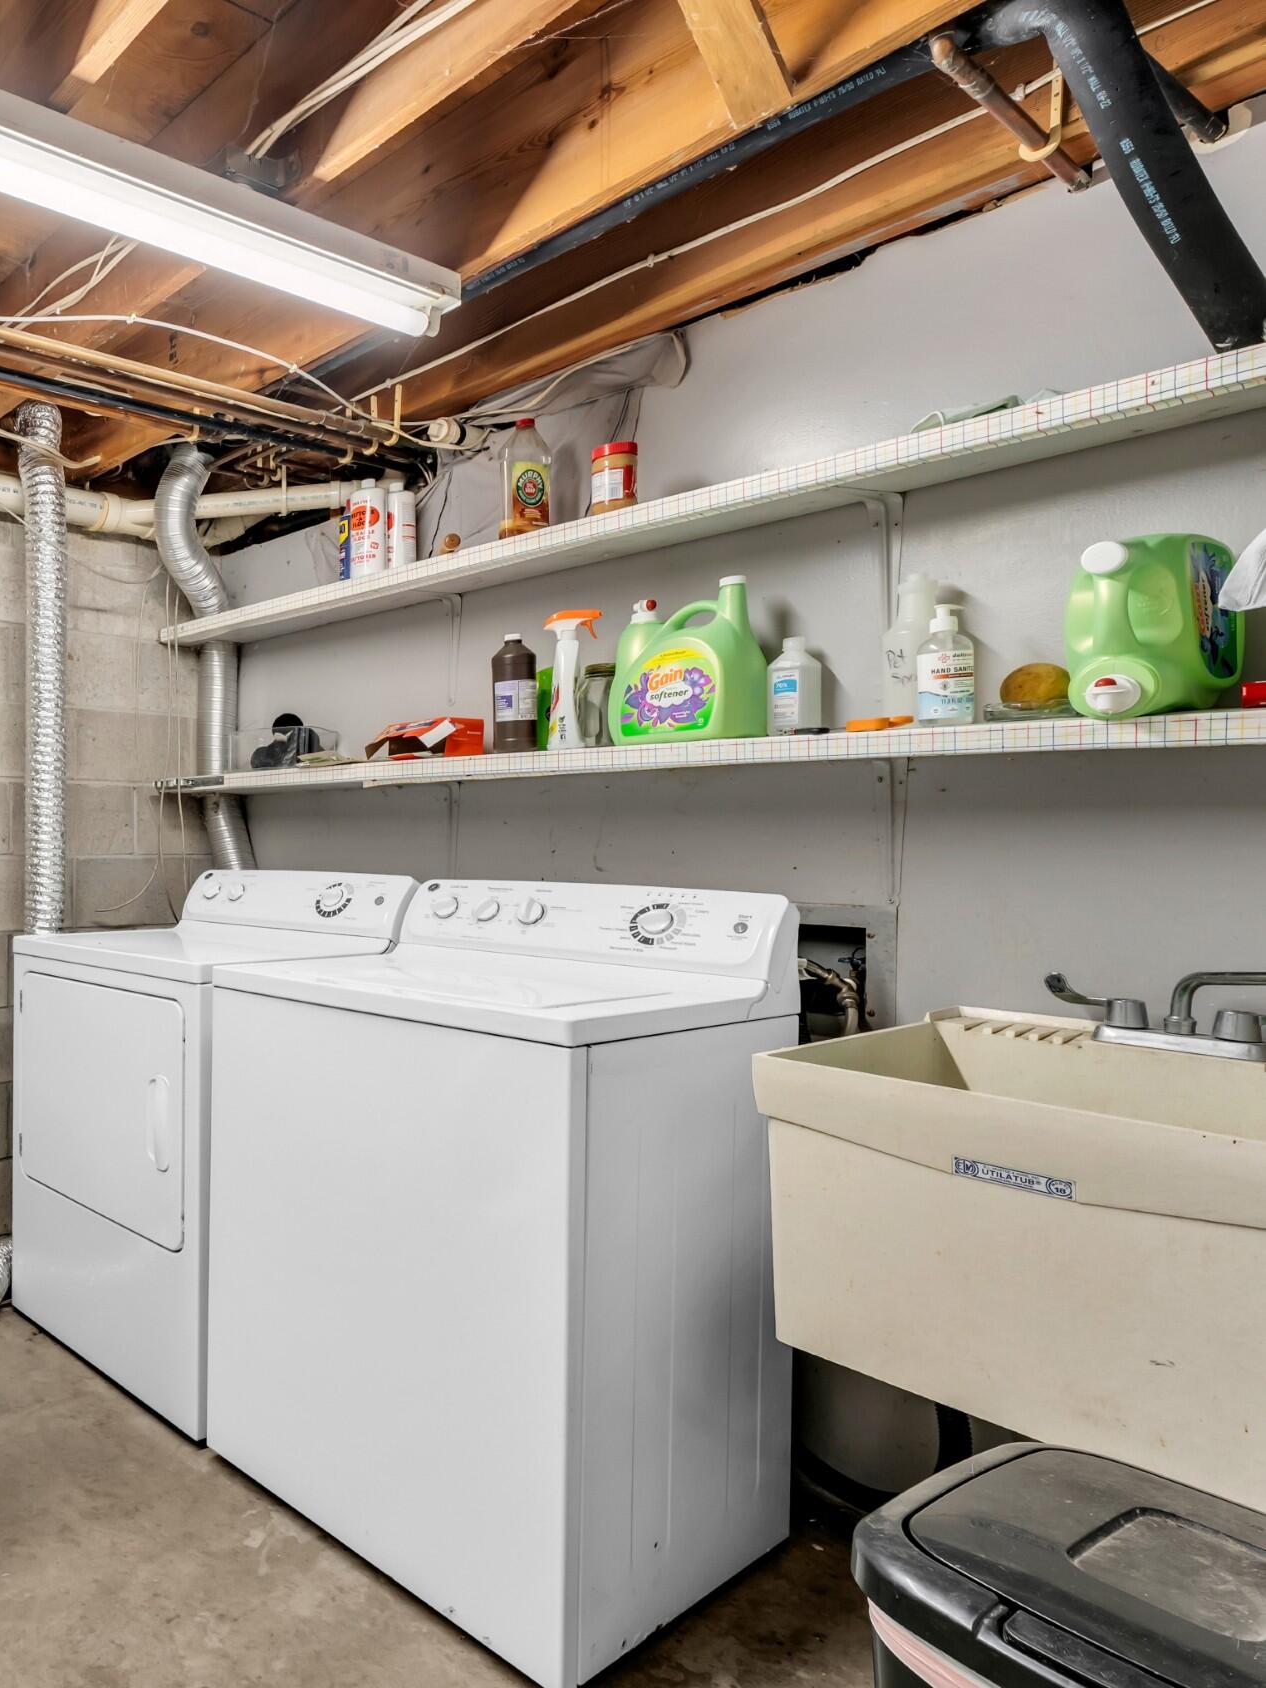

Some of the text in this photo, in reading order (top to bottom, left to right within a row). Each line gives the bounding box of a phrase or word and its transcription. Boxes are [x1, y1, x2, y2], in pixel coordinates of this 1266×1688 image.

[517, 470, 543, 489] MURPHY
[648, 667, 684, 692] Gain
[650, 689, 689, 702] softener
